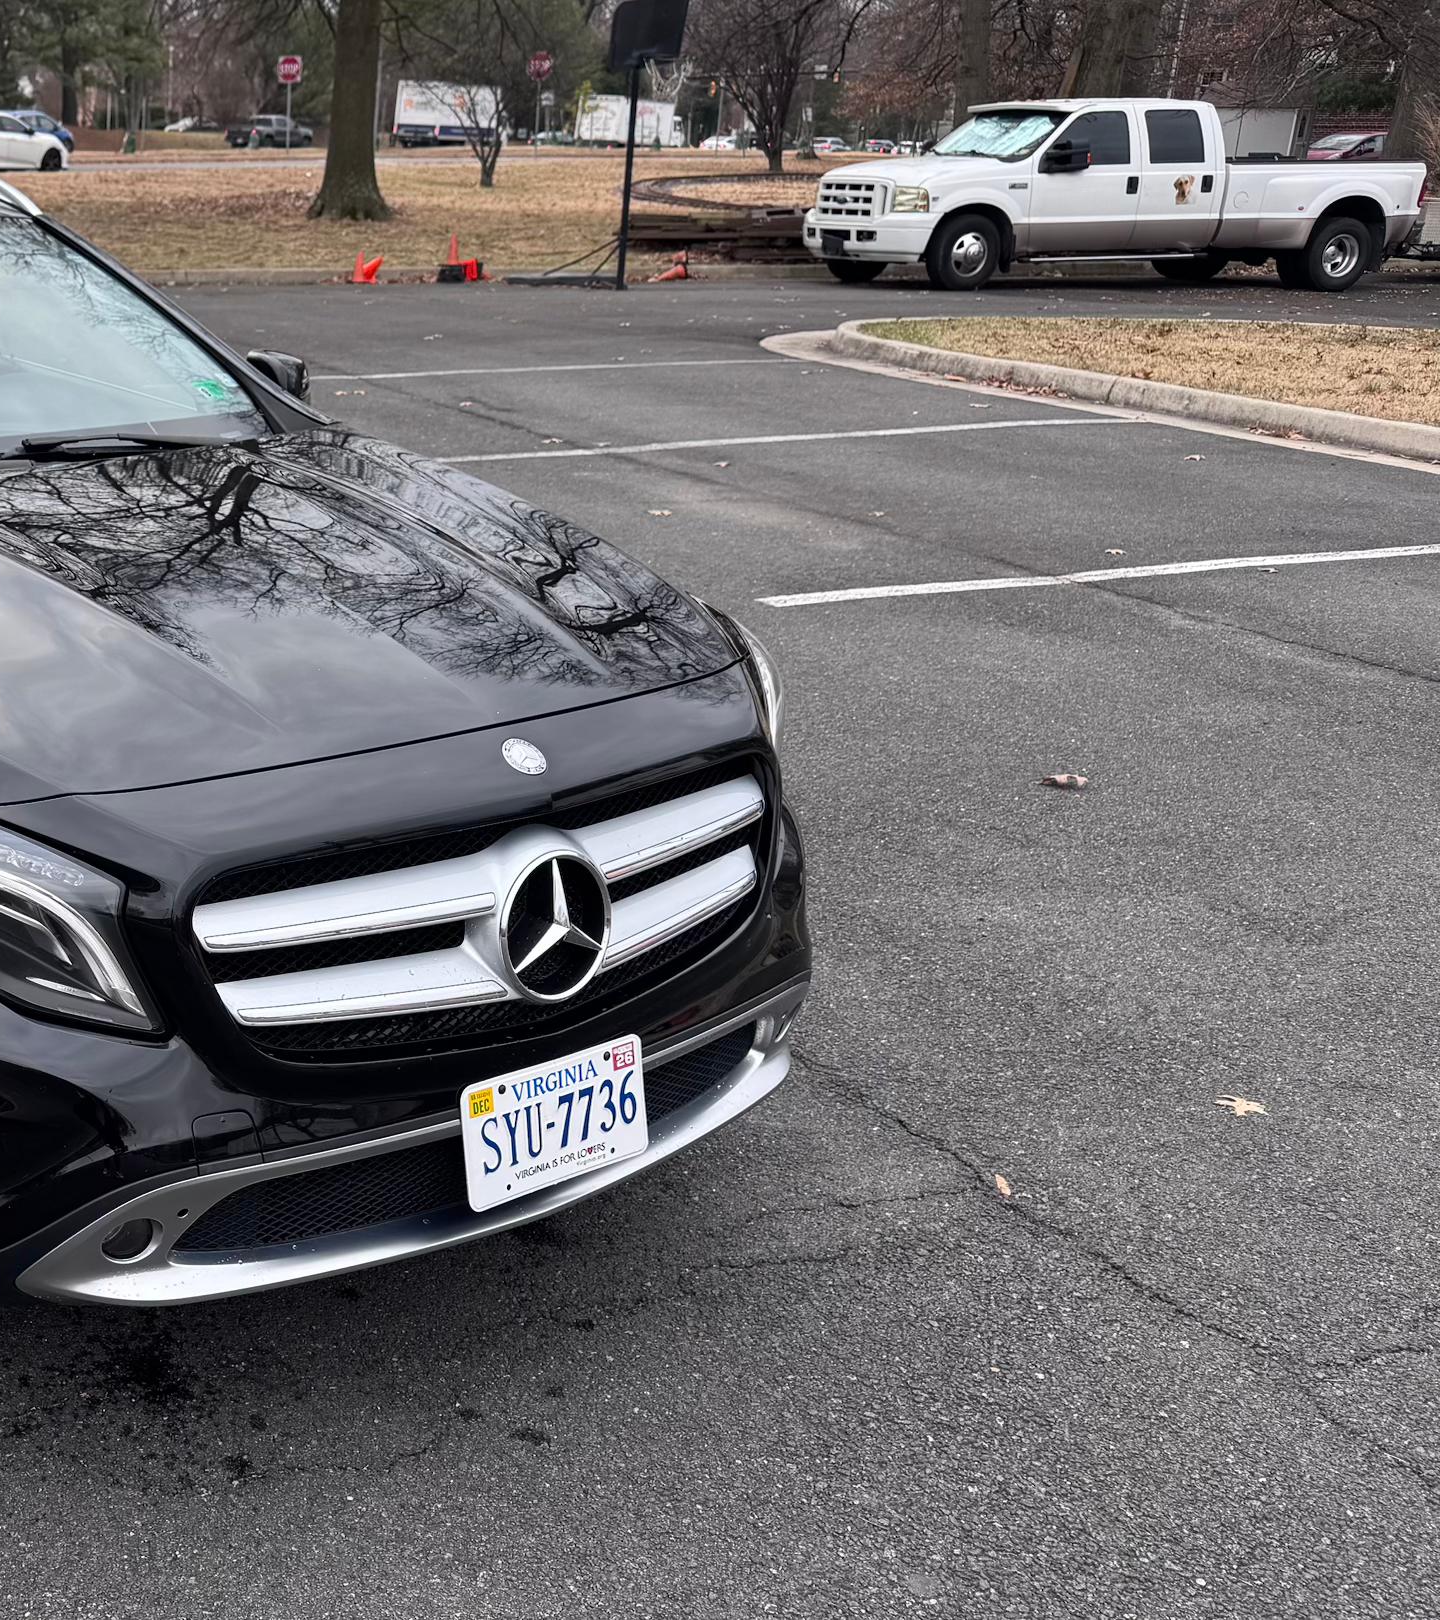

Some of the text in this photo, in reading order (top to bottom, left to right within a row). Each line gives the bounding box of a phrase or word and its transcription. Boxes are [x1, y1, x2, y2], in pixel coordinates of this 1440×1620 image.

[279, 63, 299, 74] STOP
[616, 1052, 633, 1067] 26
[511, 1060, 598, 1102] VIRGINIA
[473, 1098, 490, 1115] DEC
[481, 1069, 637, 1176] SYU-7736
[515, 1162, 551, 1180] VIRGINIA
[552, 1158, 559, 1168] IS
[560, 1152, 576, 1164] FOR
